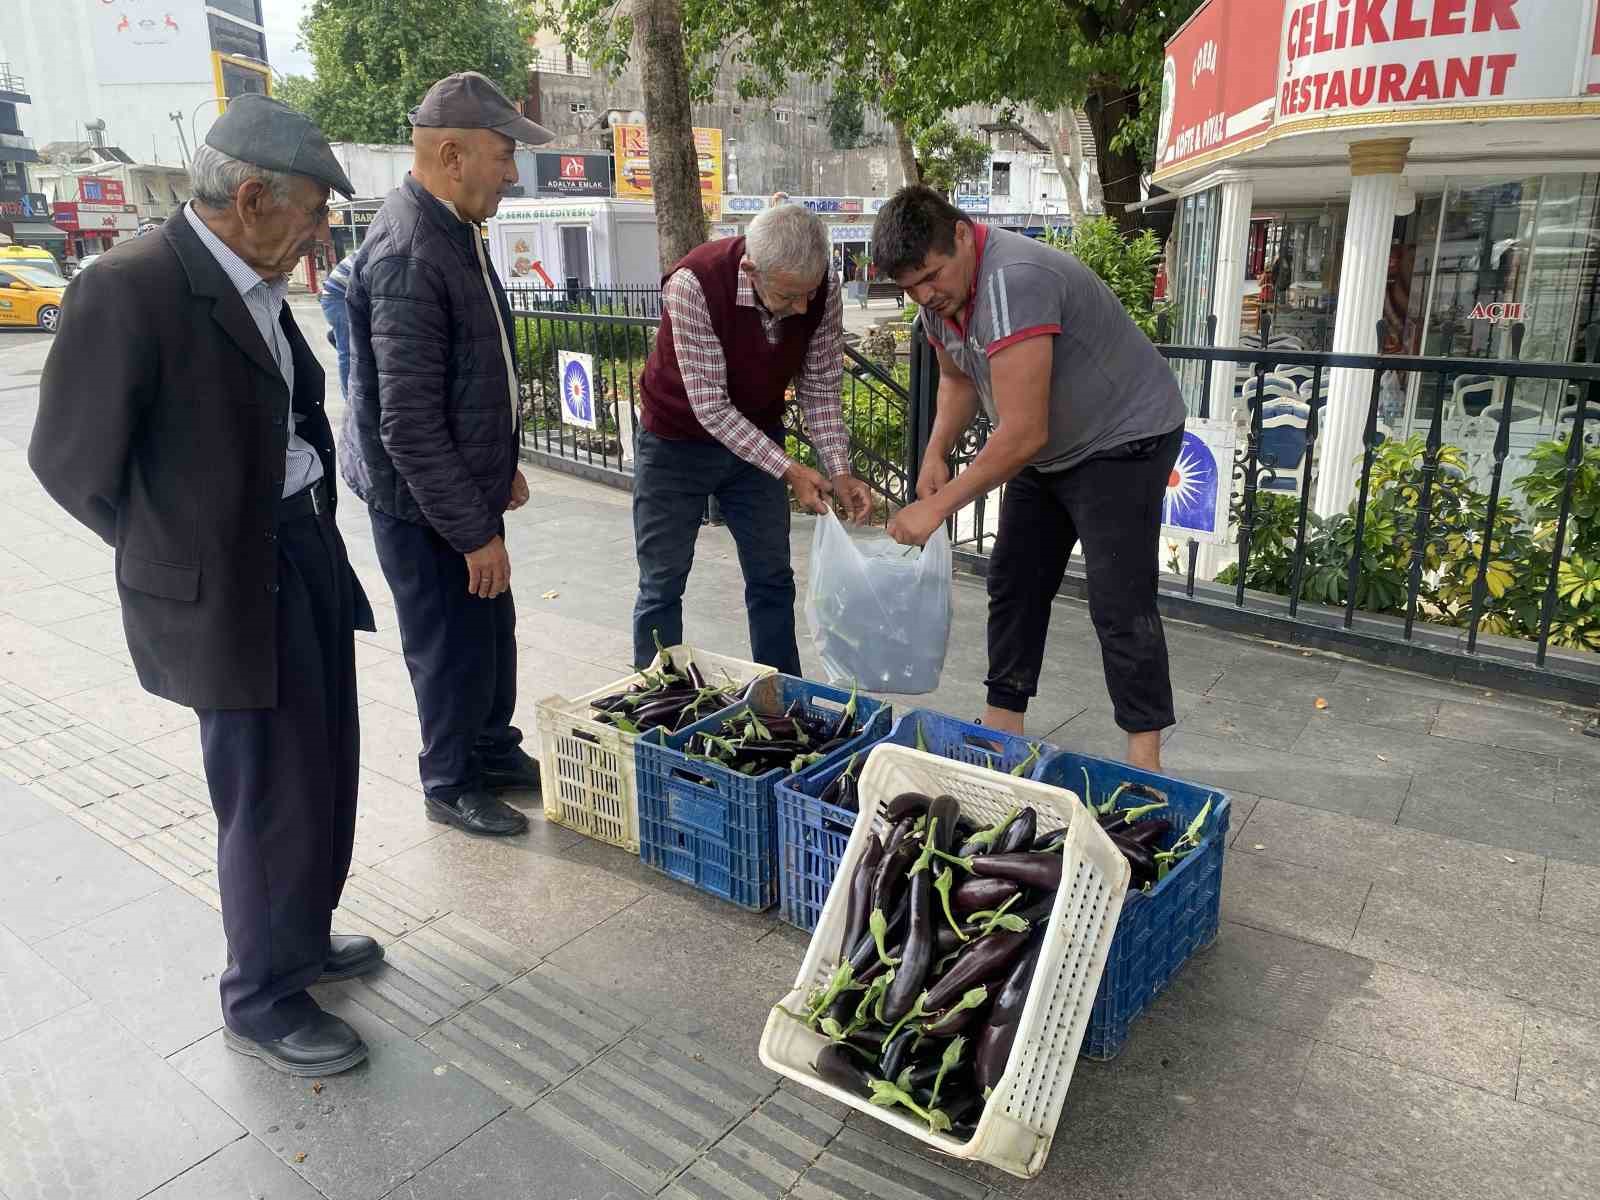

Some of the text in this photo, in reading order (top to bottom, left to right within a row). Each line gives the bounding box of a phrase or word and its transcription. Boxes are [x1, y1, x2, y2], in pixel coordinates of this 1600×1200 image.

[1280, 53, 1517, 116] RESTAURANT
[547, 181, 602, 189] ADALYA EMLAK
